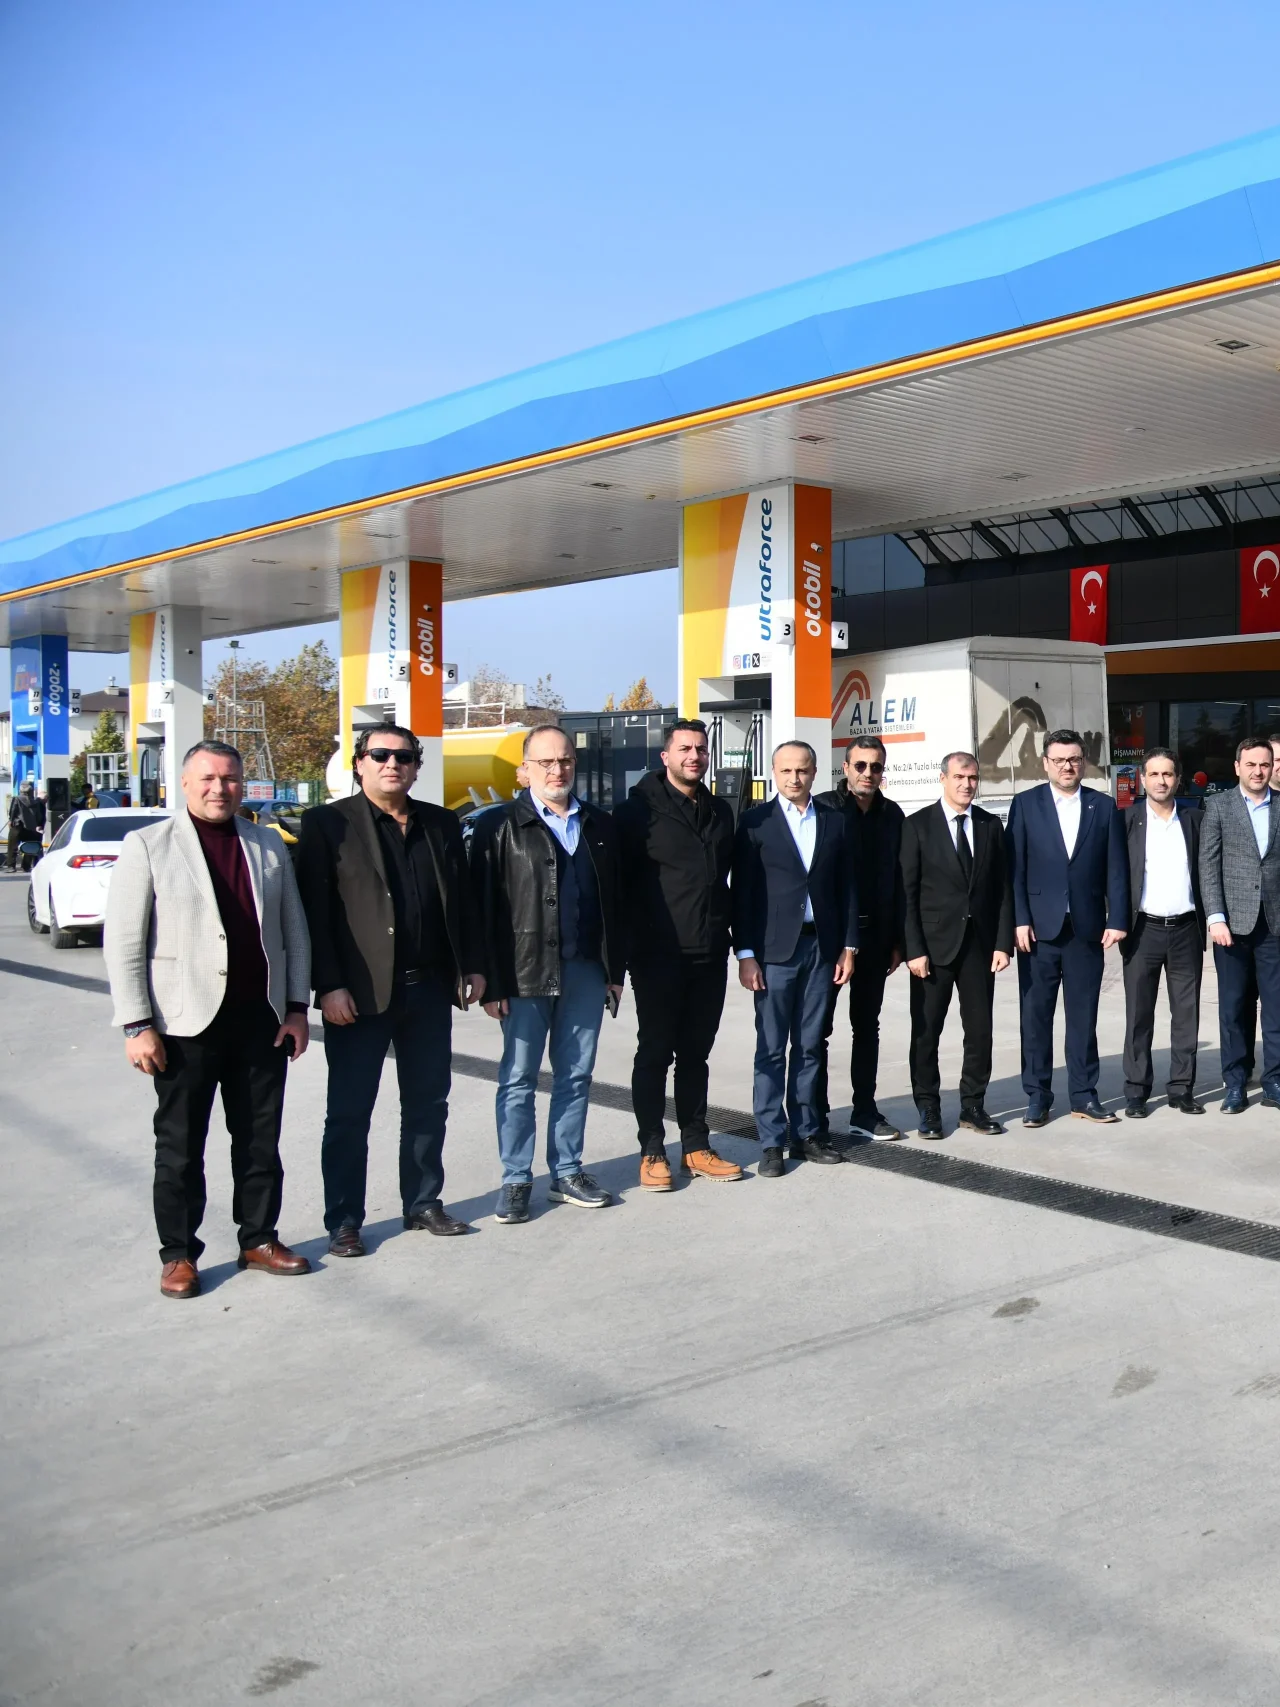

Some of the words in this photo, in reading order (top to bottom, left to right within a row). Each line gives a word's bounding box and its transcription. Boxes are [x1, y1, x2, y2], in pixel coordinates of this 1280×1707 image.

[759, 498, 772, 641] ultraforce
[803, 560, 822, 637] otobil
[783, 624, 791, 636] 3
[838, 629, 845, 642] 4
[417, 618, 434, 675] otobil
[399, 666, 406, 675] 5
[448, 669, 455, 678] 6
[48, 667, 64, 715] otogaz
[72, 692, 80, 700] 12
[207, 693, 214, 701] 8
[849, 697, 917, 726] ALEM
[850, 728, 862, 736] BAZA
[868, 724, 884, 733] YATAK
[914, 762, 930, 771] Tuzla
